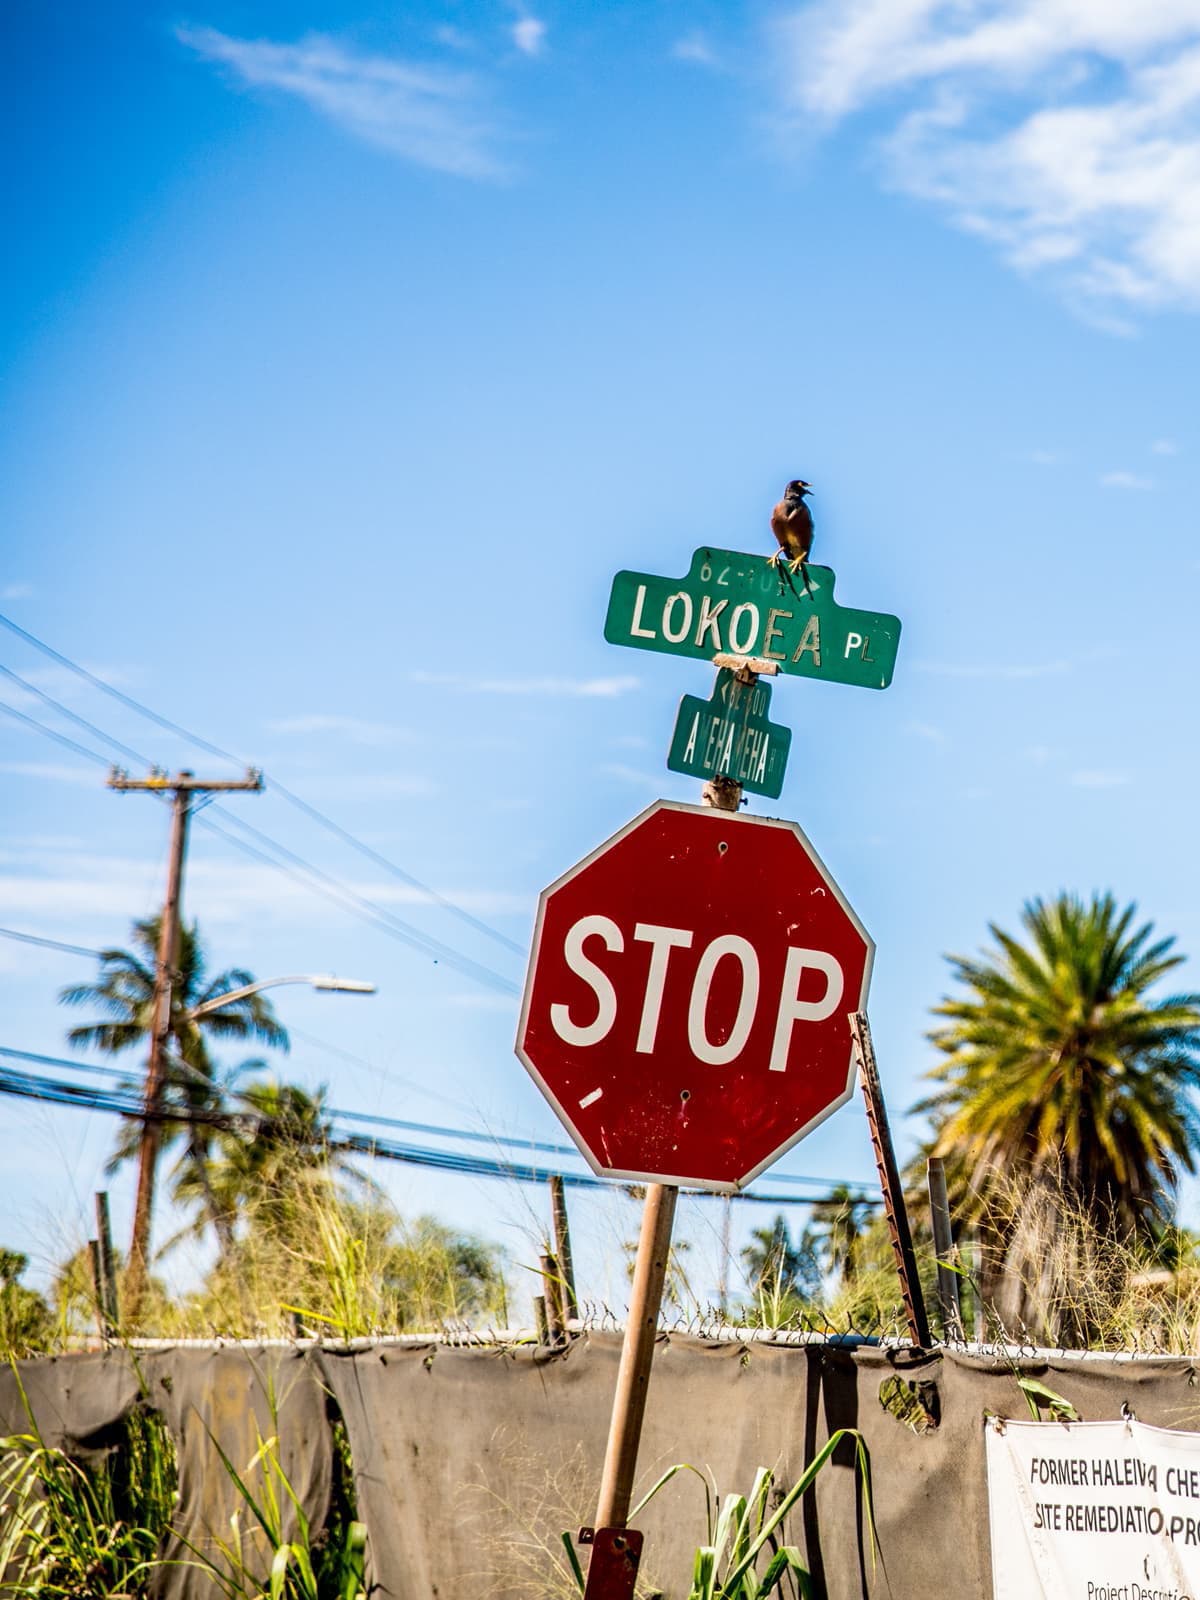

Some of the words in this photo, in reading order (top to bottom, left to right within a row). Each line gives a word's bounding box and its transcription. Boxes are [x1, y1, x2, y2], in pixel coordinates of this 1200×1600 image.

[630, 584, 821, 667] LOKOEA
[844, 631, 875, 662] PL
[550, 914, 844, 1072] STOP
[1030, 1457, 1088, 1486] FORMER
[1033, 1502, 1061, 1530] SITE
[1065, 1504, 1169, 1536] REMEDIATIO
[1087, 1581, 1128, 1600] Project
